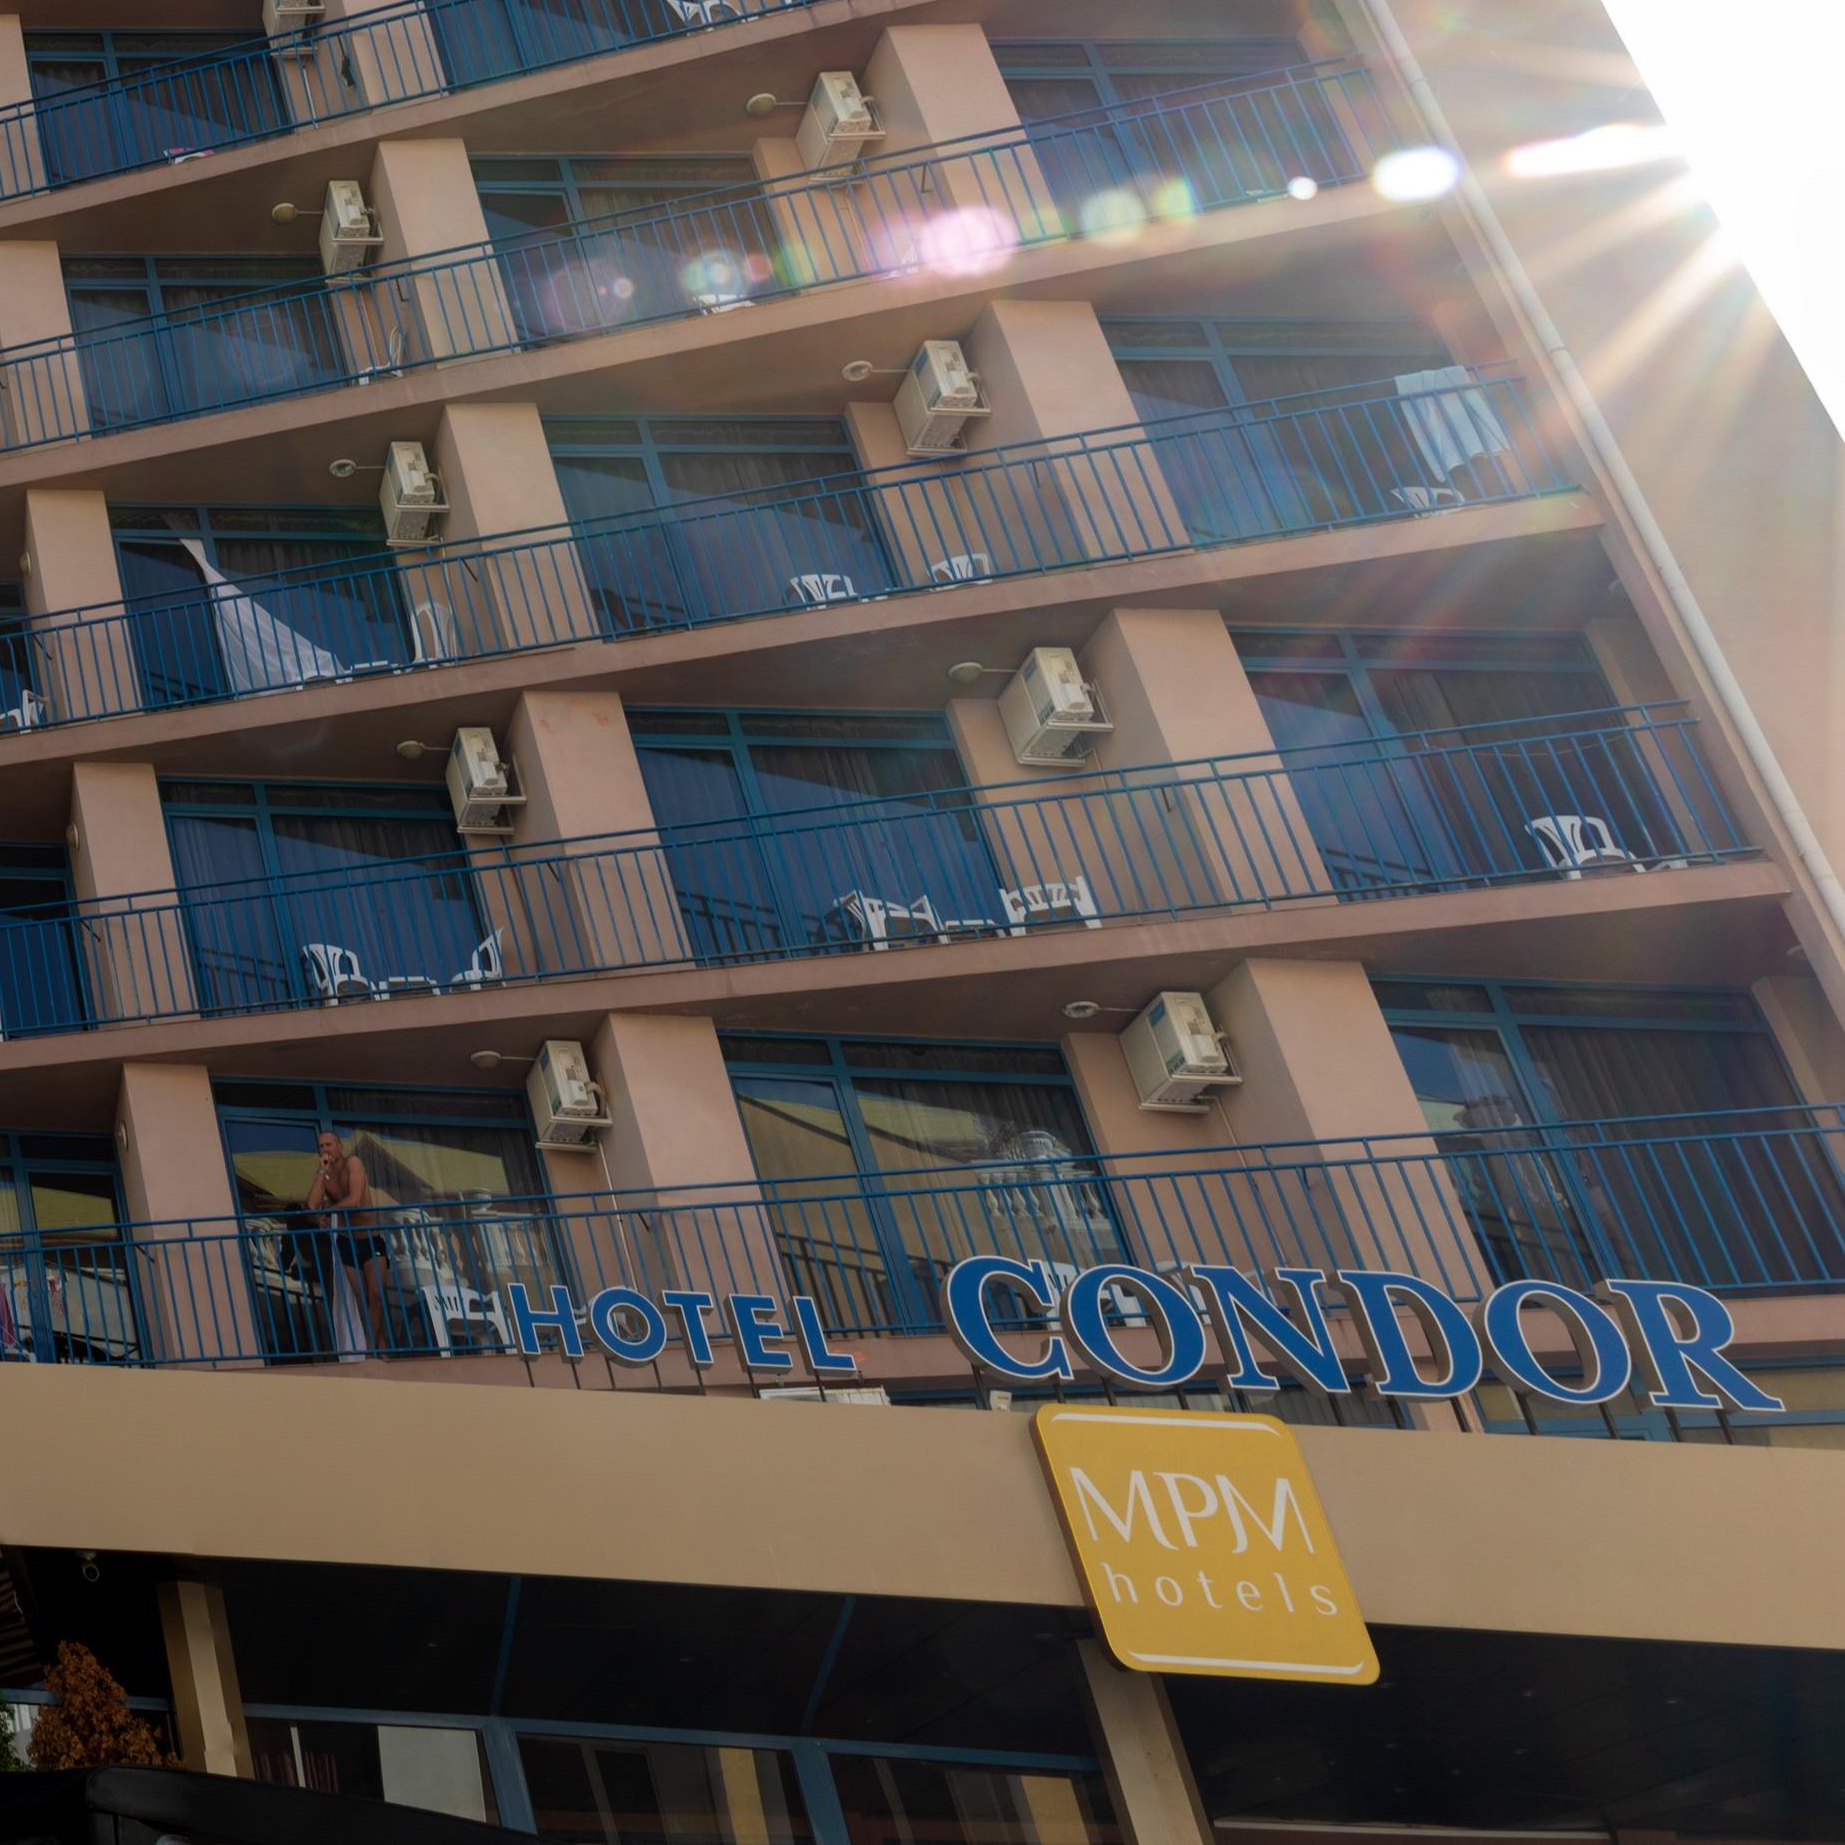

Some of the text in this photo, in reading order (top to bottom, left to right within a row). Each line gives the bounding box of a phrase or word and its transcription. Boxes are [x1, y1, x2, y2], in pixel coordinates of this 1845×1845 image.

[507, 1255, 1786, 1412] HOTEL CONDOR
[1069, 1467, 1315, 1554] MPM
[1100, 1562, 1338, 1616] hotels
